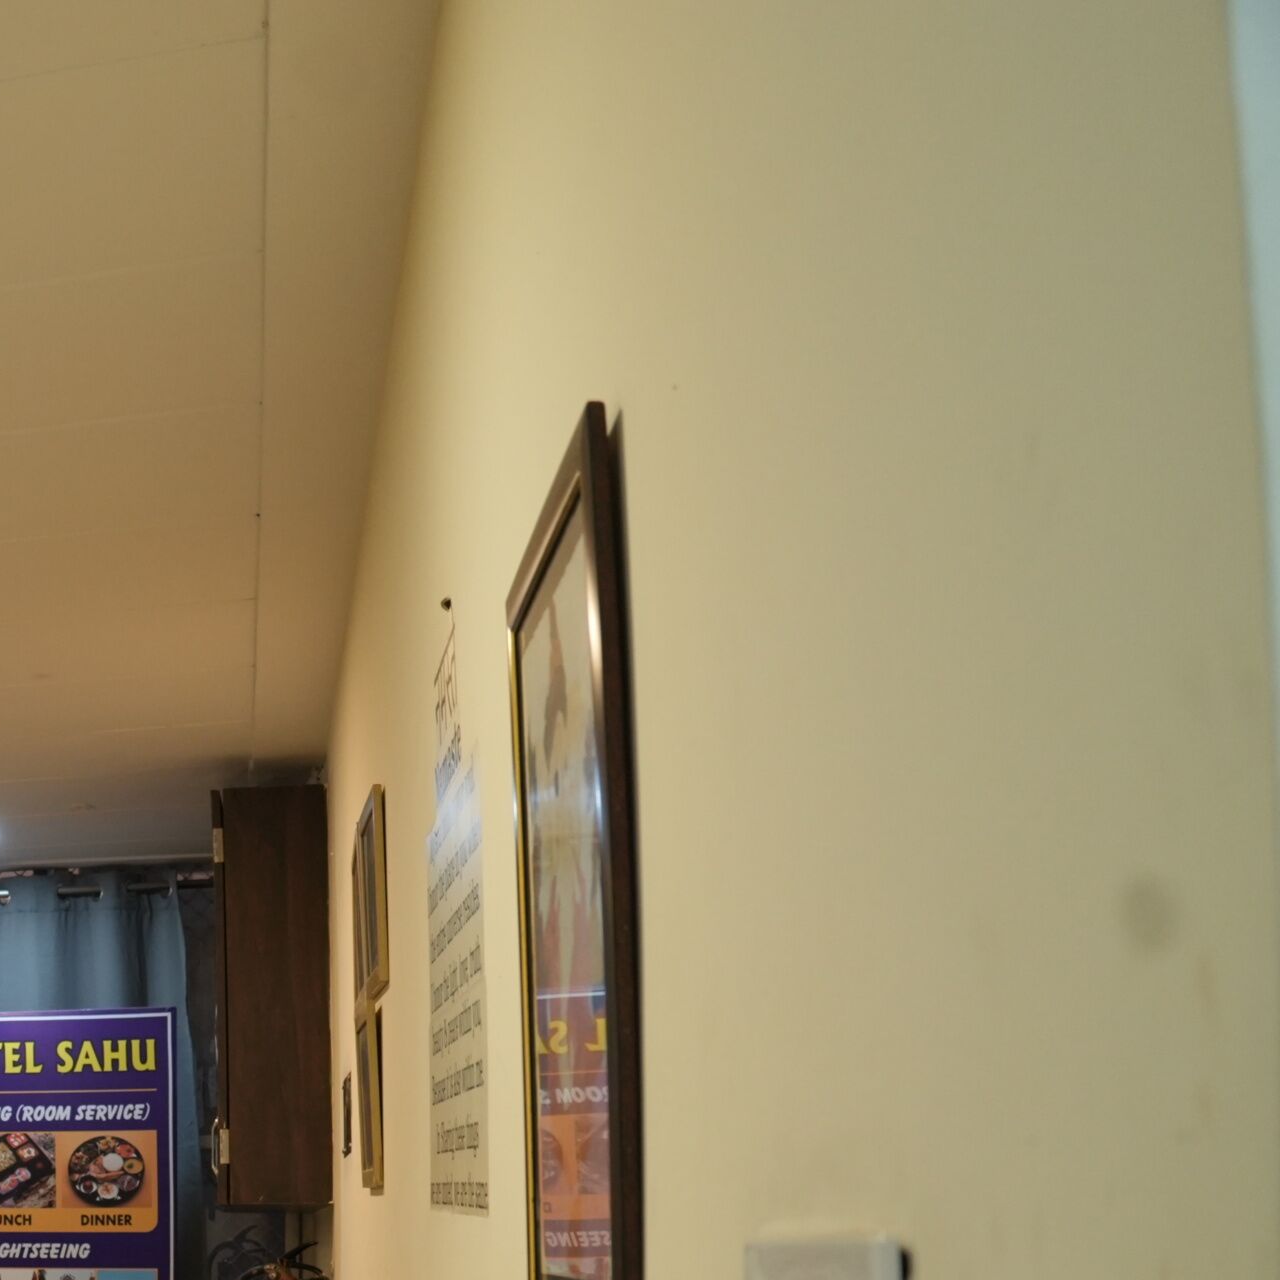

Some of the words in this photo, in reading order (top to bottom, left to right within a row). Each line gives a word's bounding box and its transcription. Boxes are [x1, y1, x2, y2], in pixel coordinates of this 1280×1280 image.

[56, 1039, 156, 1074] SAHU
[15, 1105, 71, 1123] (ROOM
[75, 1103, 150, 1121] SERVICE)
[80, 1215, 132, 1227] DINNER
